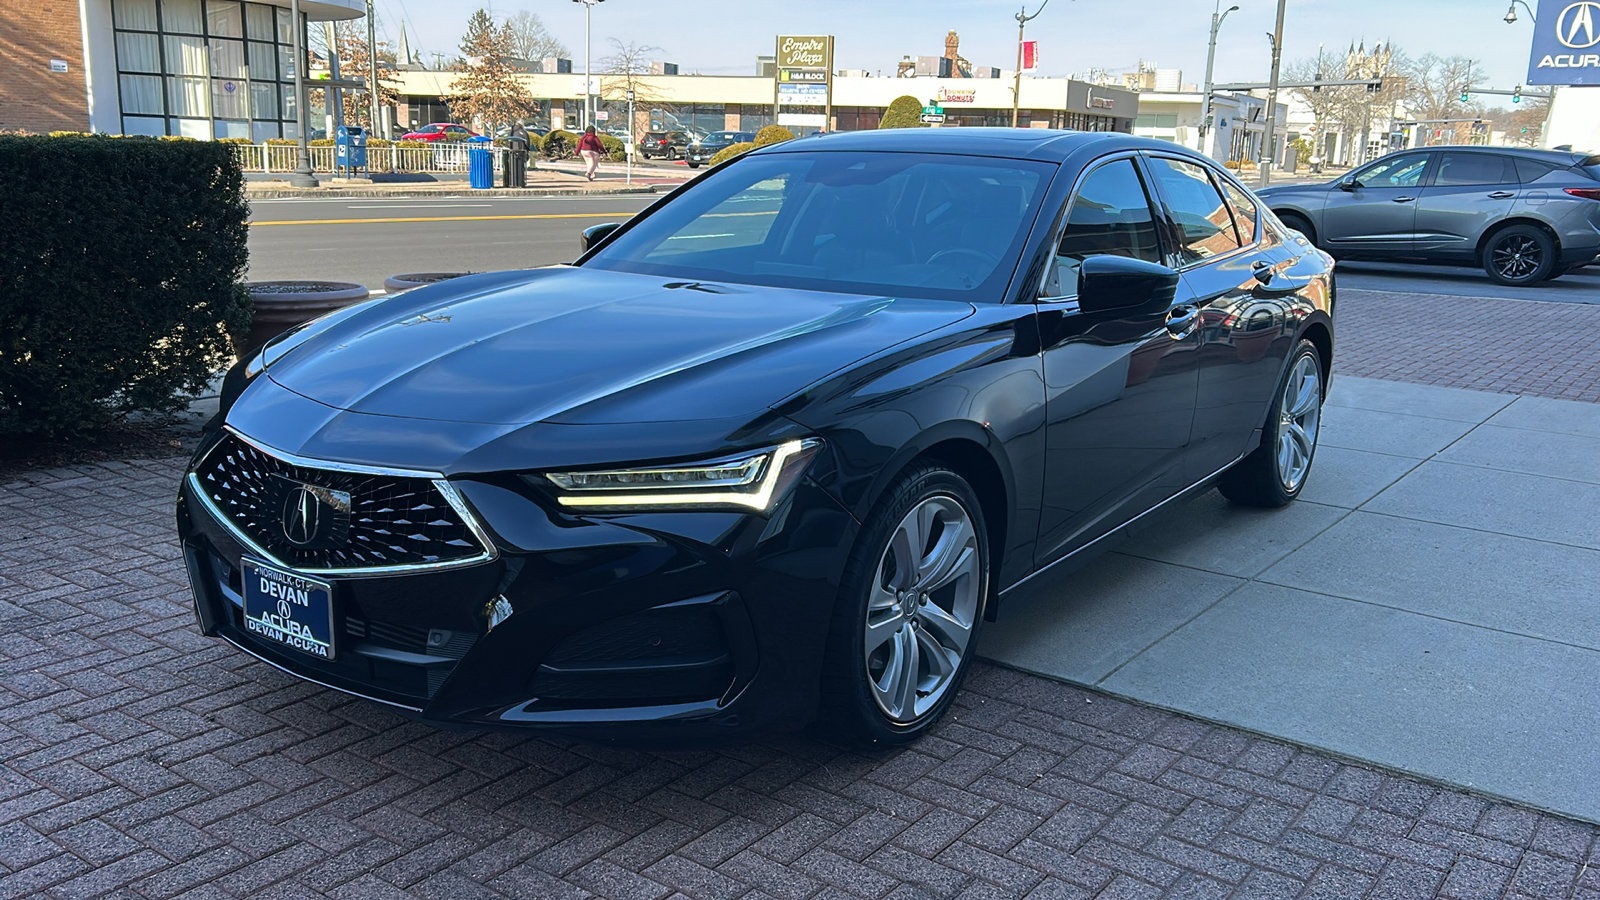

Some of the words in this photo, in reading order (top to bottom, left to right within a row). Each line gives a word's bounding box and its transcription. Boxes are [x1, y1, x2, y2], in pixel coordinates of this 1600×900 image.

[782, 37, 824, 53] Empire
[786, 50, 823, 65] Plaza
[1537, 54, 1600, 68] ACUR
[946, 95, 975, 103] DONUTS
[295, 578, 306, 589] CT
[260, 577, 309, 607] DEVAN
[261, 611, 314, 641] ACURA
[248, 620, 283, 641] DEVAN
[286, 635, 327, 657] ACURA
